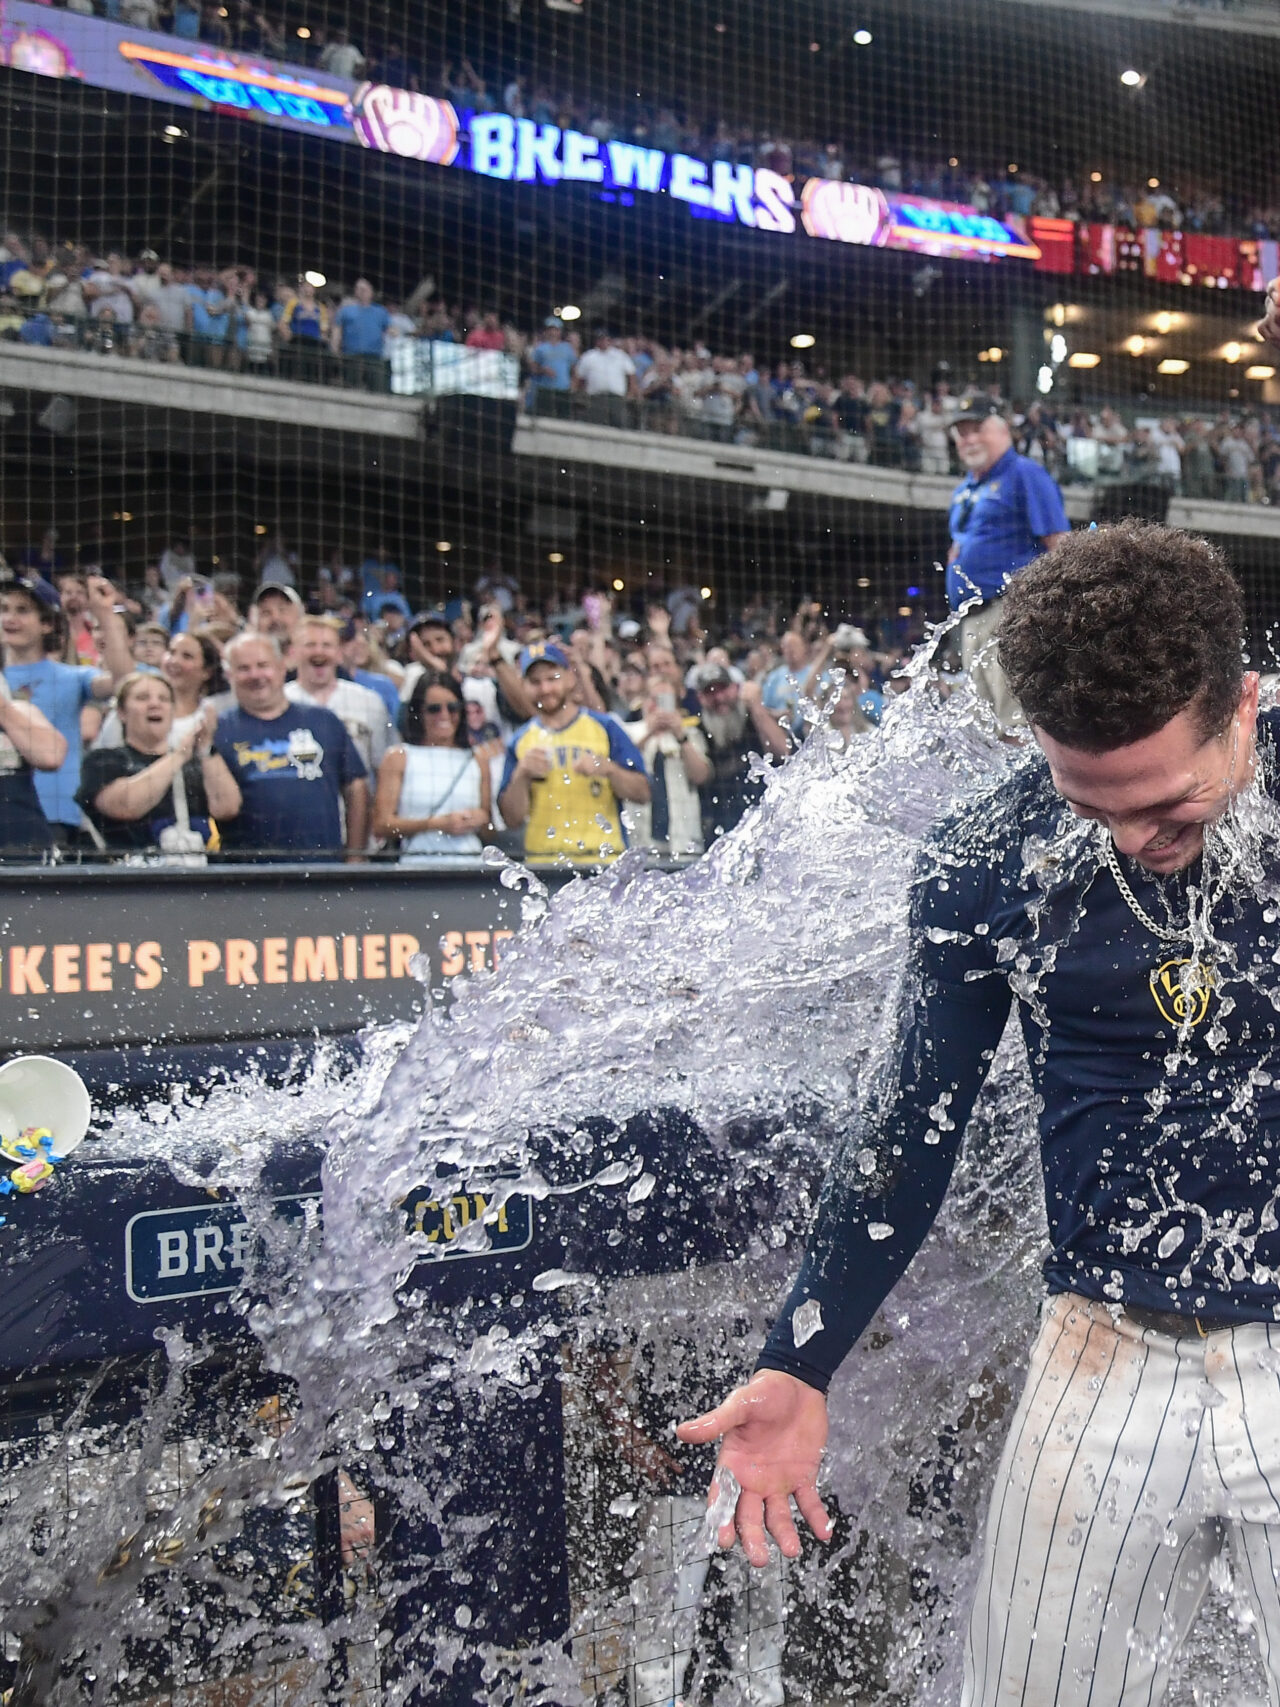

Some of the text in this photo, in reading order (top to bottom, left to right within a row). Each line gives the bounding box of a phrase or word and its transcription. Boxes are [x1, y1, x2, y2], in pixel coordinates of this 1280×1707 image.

[469, 112, 795, 234] BREWERS
[0, 941, 163, 995] KEE'S
[188, 933, 421, 988] PREMIER
